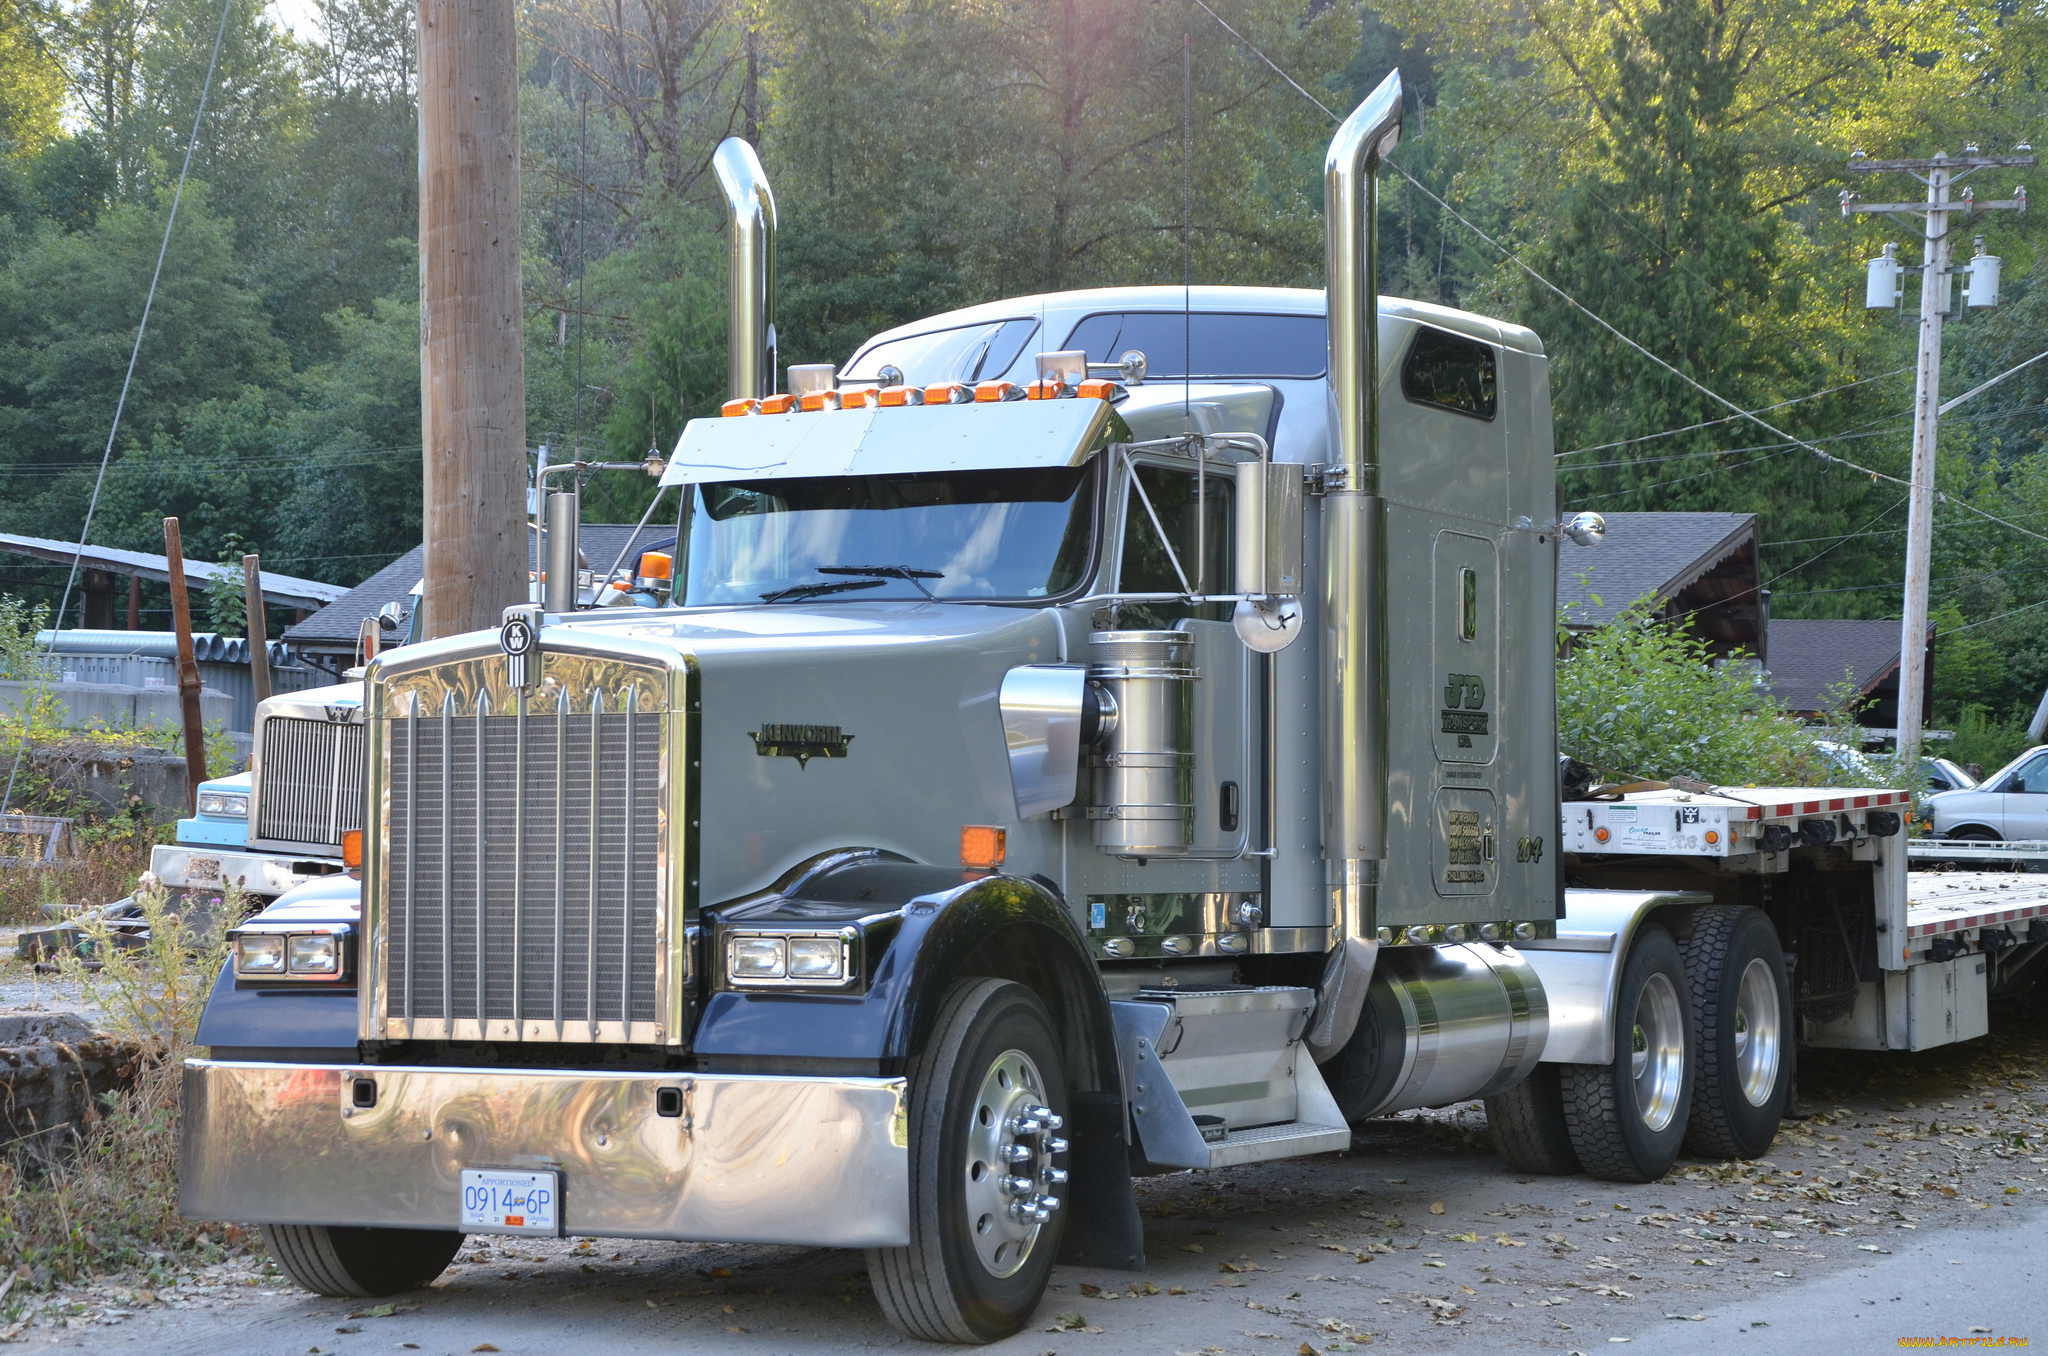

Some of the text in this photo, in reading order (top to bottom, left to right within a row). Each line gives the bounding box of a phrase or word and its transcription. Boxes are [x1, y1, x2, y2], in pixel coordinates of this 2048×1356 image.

[1444, 673, 1485, 710] JD
[1442, 712, 1488, 731] TRANSPORT
[762, 723, 842, 743] KENWORTH
[1517, 836, 1543, 864] 204
[481, 1178, 534, 1187] APPORTIONED
